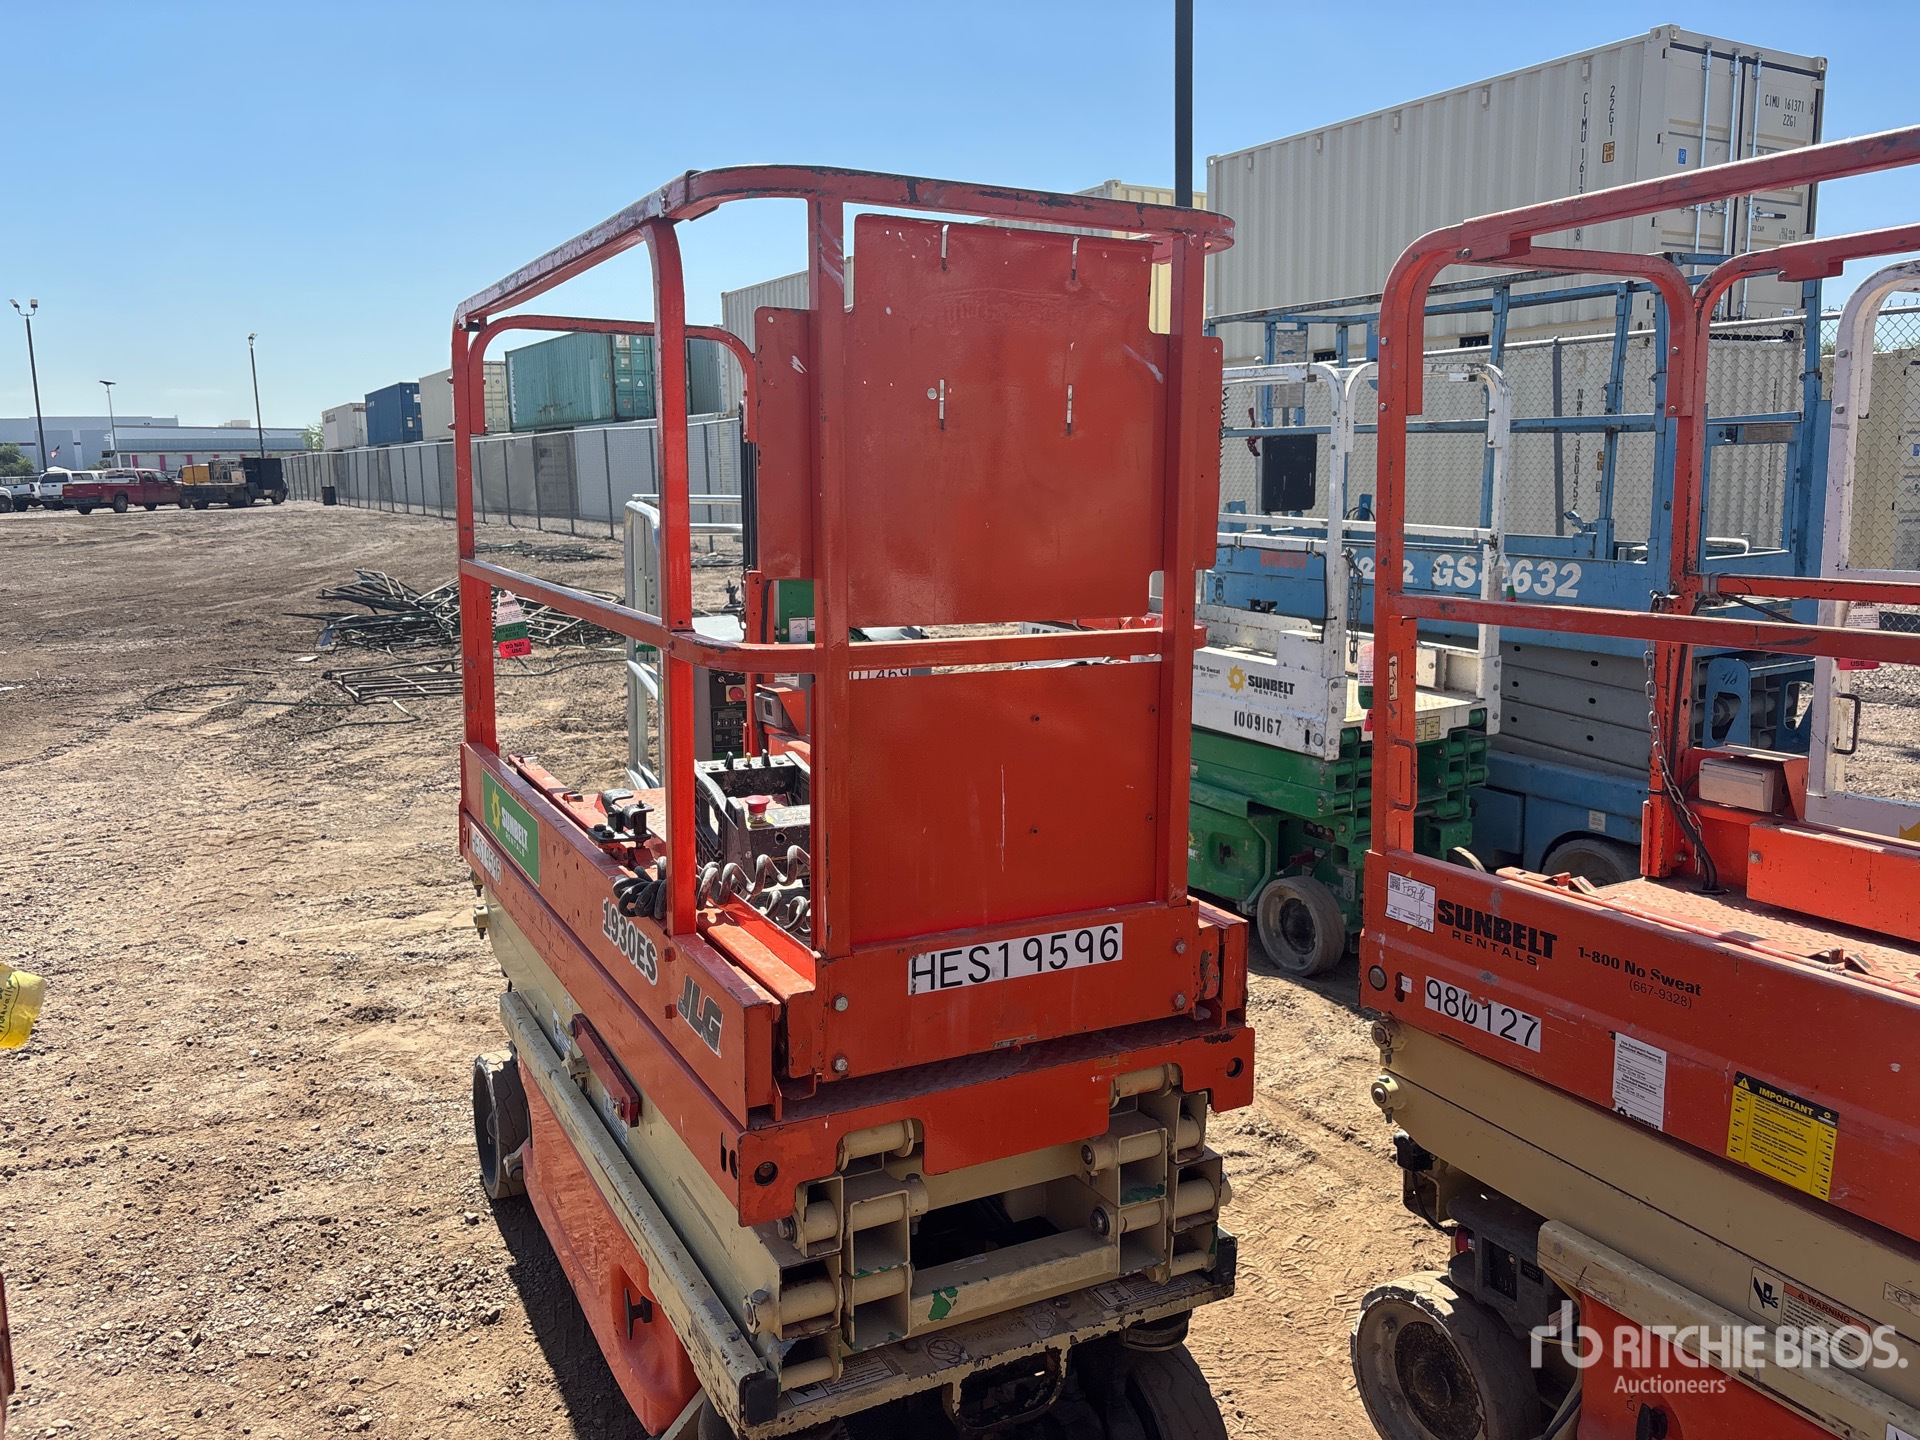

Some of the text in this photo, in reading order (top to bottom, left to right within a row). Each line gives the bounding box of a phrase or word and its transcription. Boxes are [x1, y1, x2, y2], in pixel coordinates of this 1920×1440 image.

[1608, 85, 1616, 137] 22G1
[1764, 94, 1780, 109] CIMU
[1784, 97, 1805, 114] 161371
[1782, 114, 1797, 128] 22G1
[1432, 553, 1583, 599] GS632
[1247, 674, 1295, 696] SUNBELT
[1253, 688, 1288, 700] RENTALS
[1233, 709, 1282, 737] 1009167
[501, 806, 528, 852] SUNBELT
[602, 897, 659, 986] 1930ES
[1437, 898, 1558, 960] SUNBELT
[1452, 930, 1538, 967] RENTALS
[911, 925, 1119, 995] HES19596
[1578, 946, 1703, 997] 1-800 No Sweat
[1426, 979, 1539, 1047] 980127
[1628, 978, 1693, 1010] (667-9328)
[676, 973, 724, 1058] JLG
[1759, 1086, 1814, 1116] IMPORTANT
[1808, 1295, 1850, 1324] WARNING
